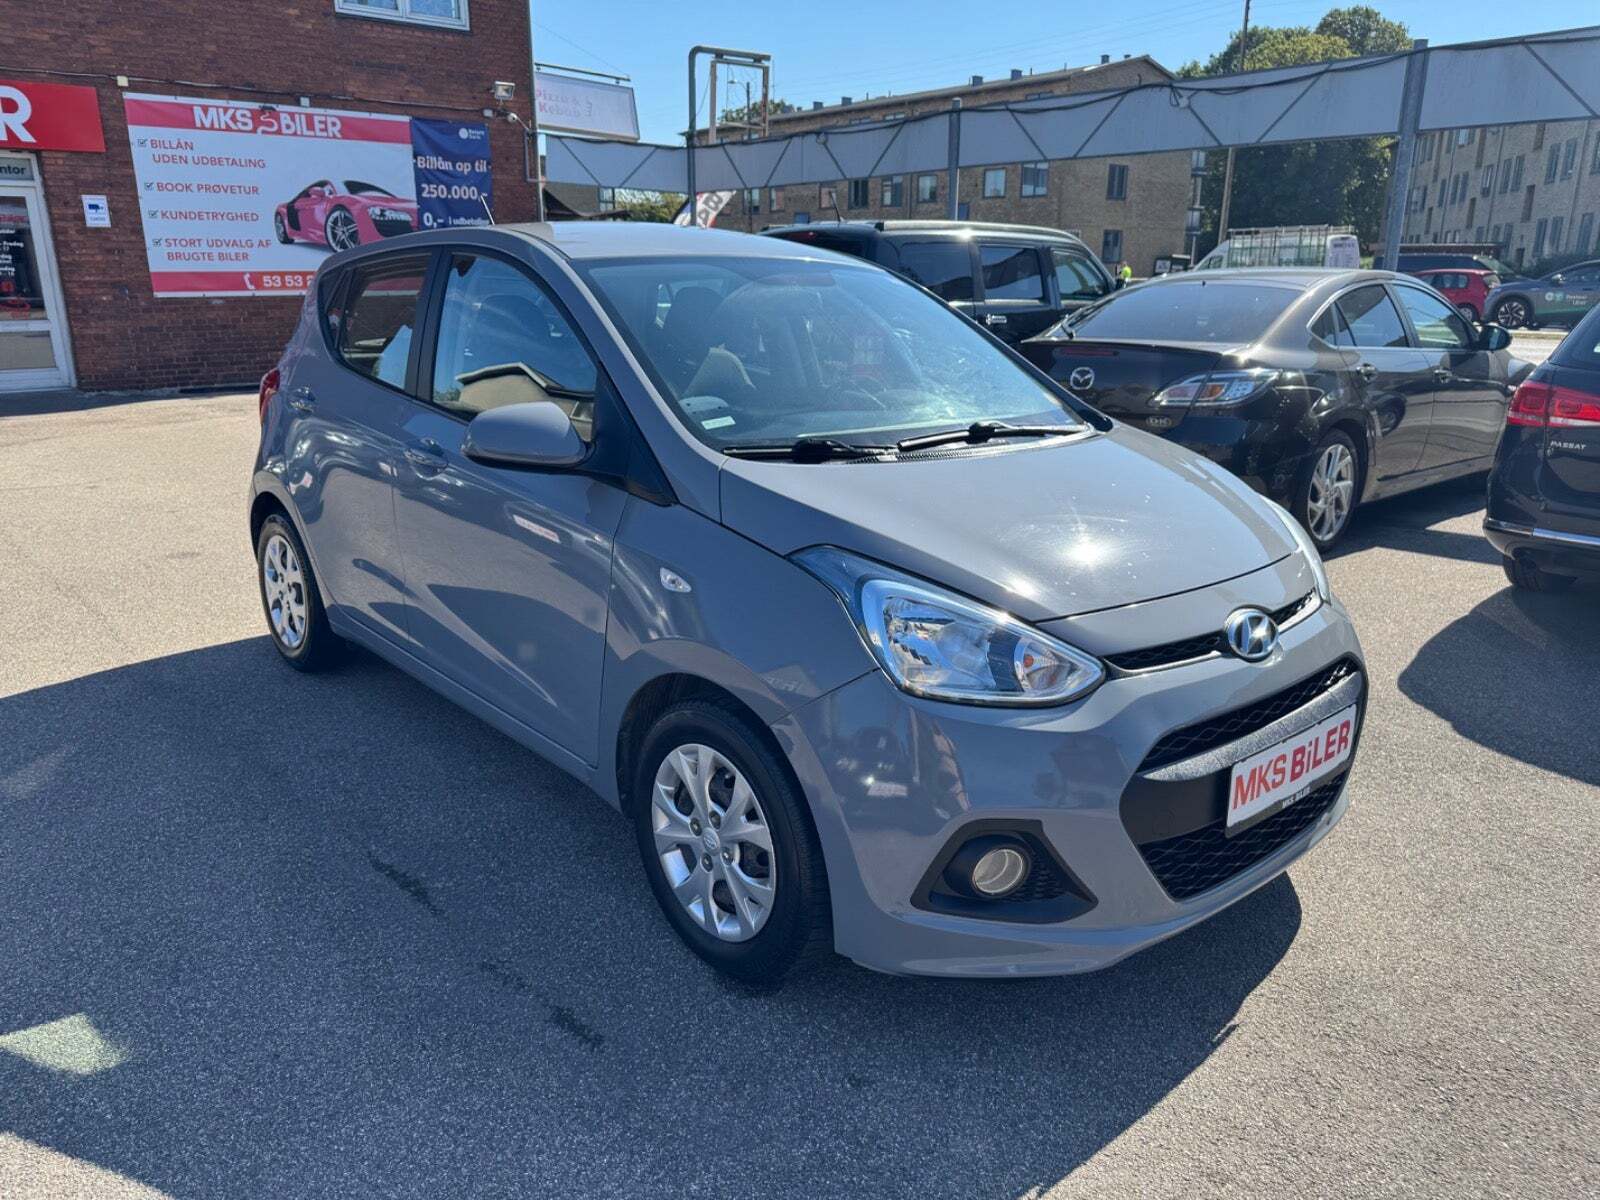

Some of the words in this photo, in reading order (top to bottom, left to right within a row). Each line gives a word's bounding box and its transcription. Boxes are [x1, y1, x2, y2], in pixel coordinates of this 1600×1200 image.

[193, 105, 254, 131] MKS
[150, 138, 194, 150] BILLÅN
[152, 153, 189, 165] UDEN
[192, 154, 267, 168] UDBETALING
[416, 156, 454, 171] Billån
[455, 163, 471, 175] op
[474, 160, 488, 173] til
[156, 182, 193, 193] BOOK
[196, 183, 260, 195] PRØVETUR
[160, 210, 260, 222] KUNDETRYGHED
[165, 238, 202, 248] STORT
[206, 239, 254, 249] UDVALG
[257, 239, 273, 248] AF
[167, 251, 216, 261] BRUGTE
[218, 252, 250, 261] BILER
[263, 274, 282, 287] 53
[285, 274, 304, 287] 53
[1550, 440, 1588, 449] PASSAT
[1233, 753, 1287, 810] MKS
[1289, 719, 1351, 783] BiLER
